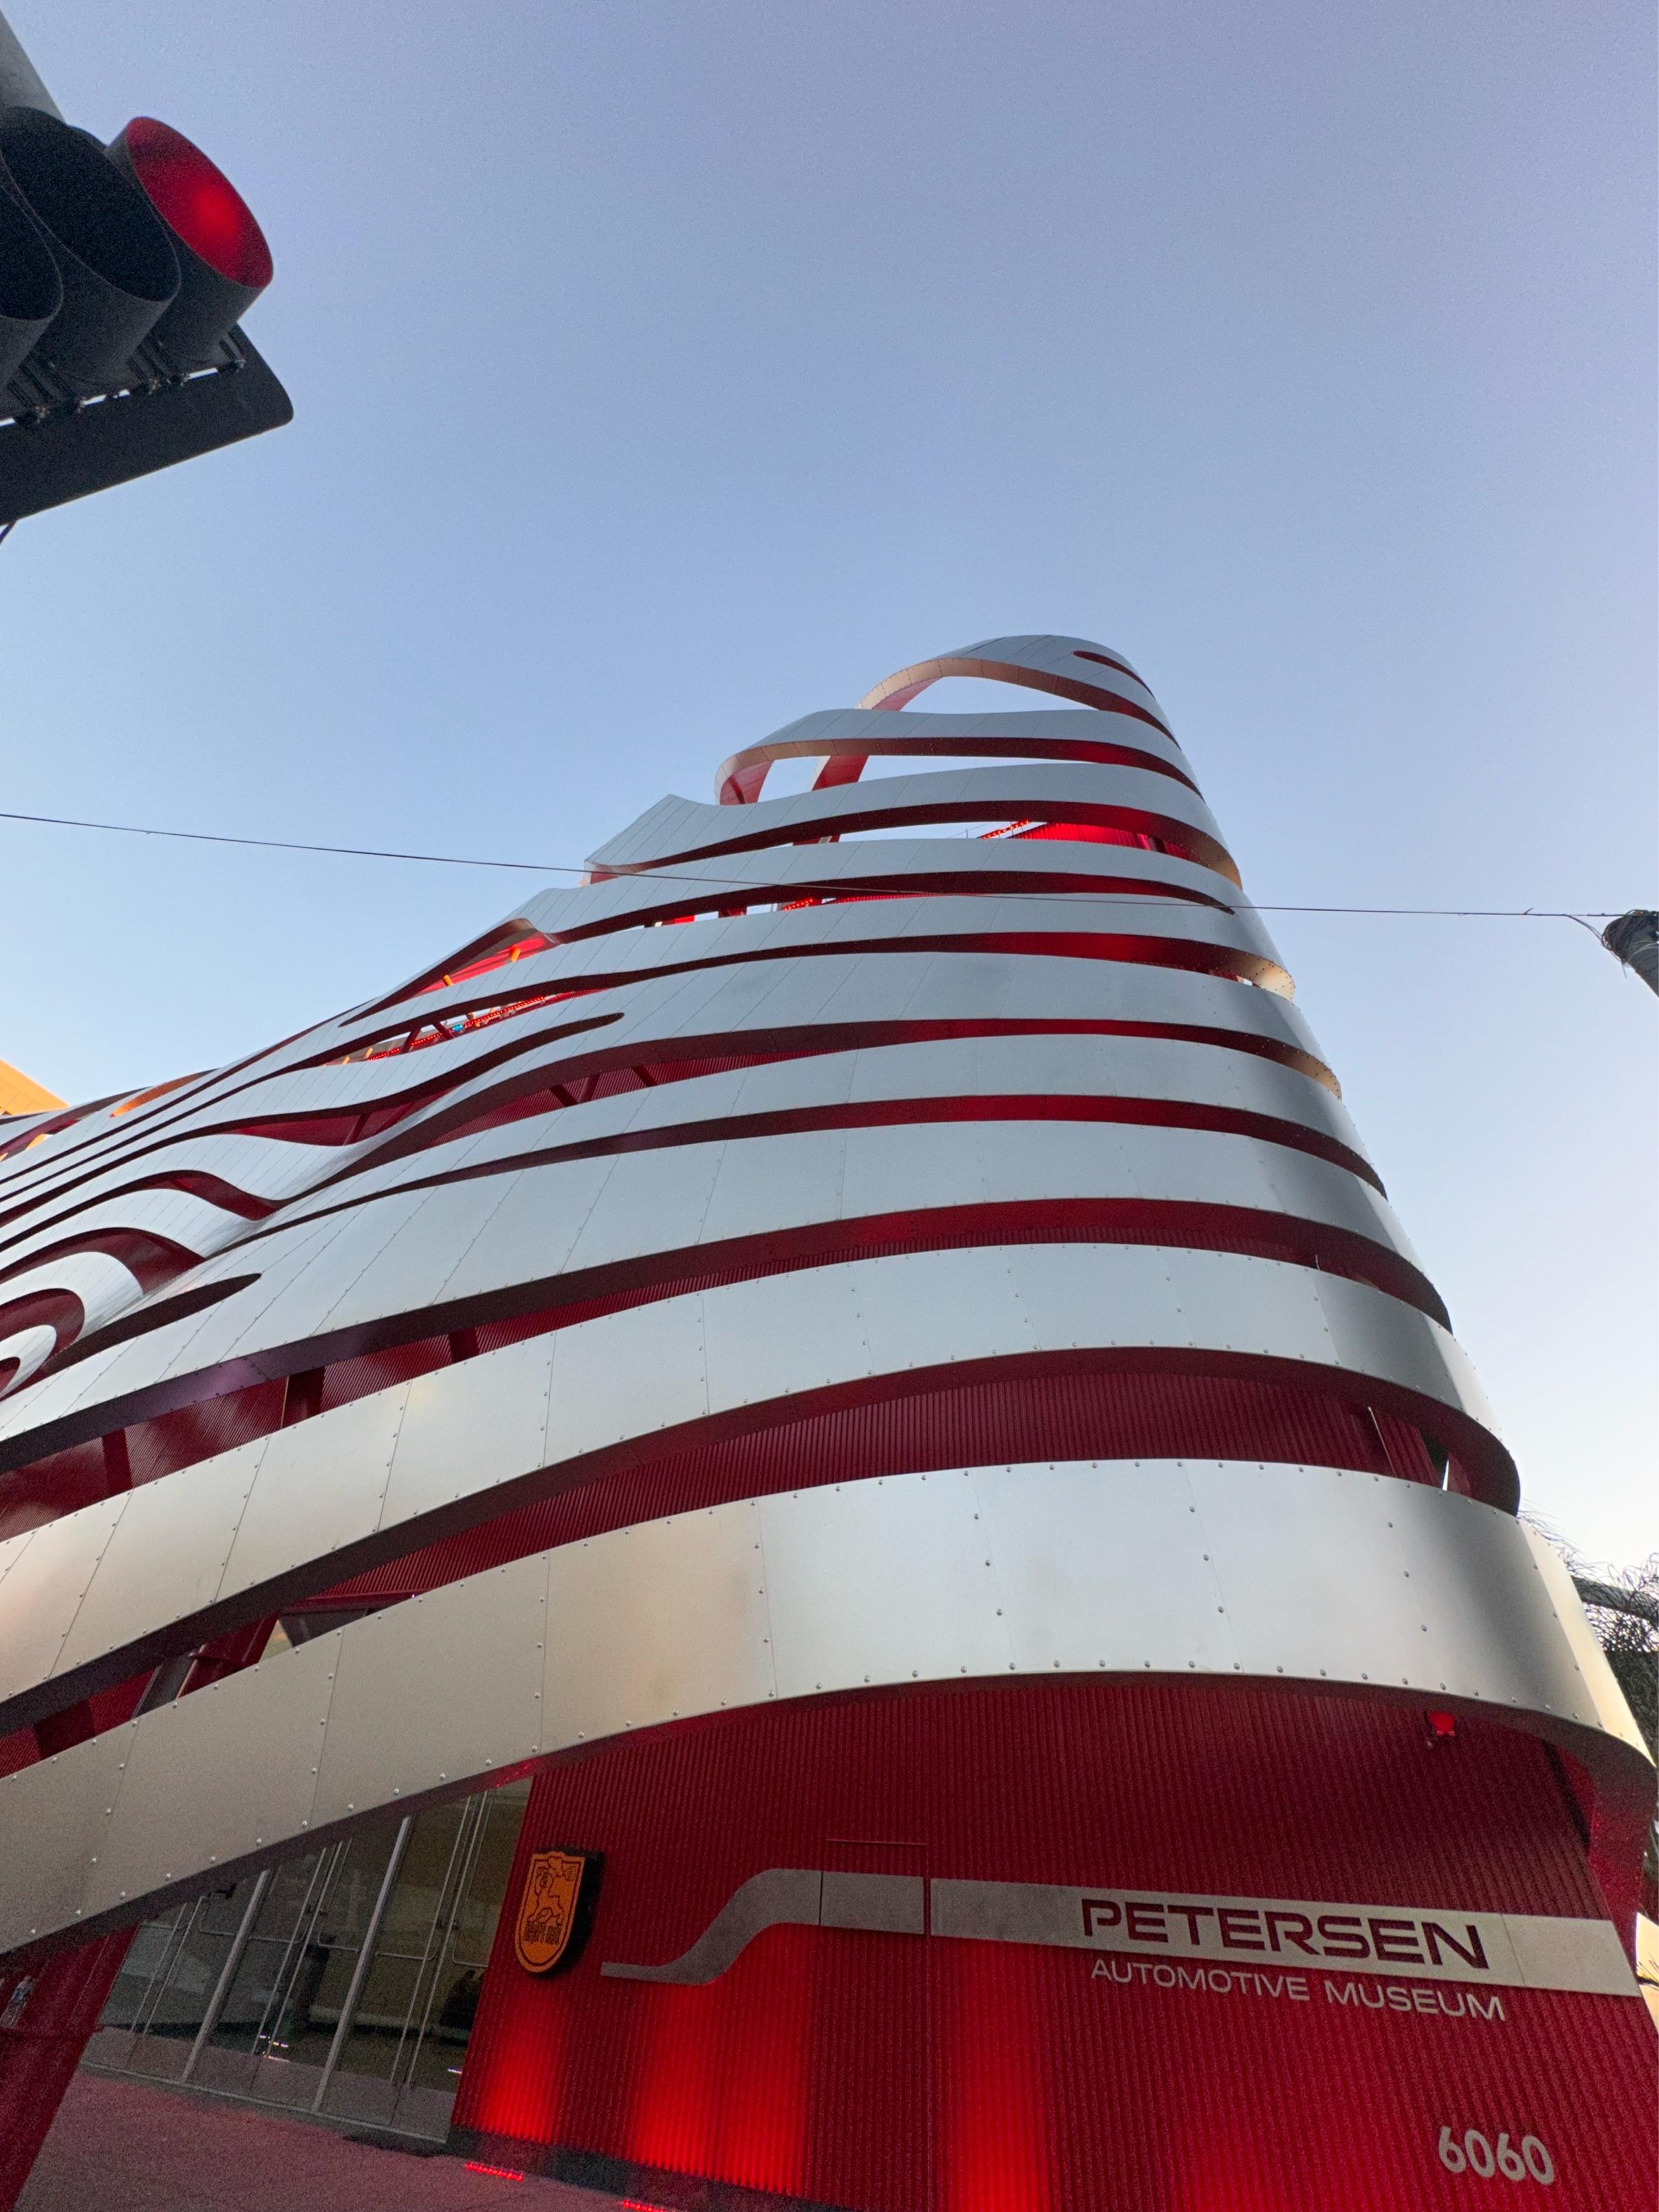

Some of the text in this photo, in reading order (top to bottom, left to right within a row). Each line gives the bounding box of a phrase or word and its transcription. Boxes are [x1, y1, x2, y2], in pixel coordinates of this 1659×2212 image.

[1082, 1898, 1489, 1970] PETERSEN
[1091, 1959, 1505, 2021] AUTOMOTIVE MUSEUM
[1438, 2125, 1555, 2185] 6060
